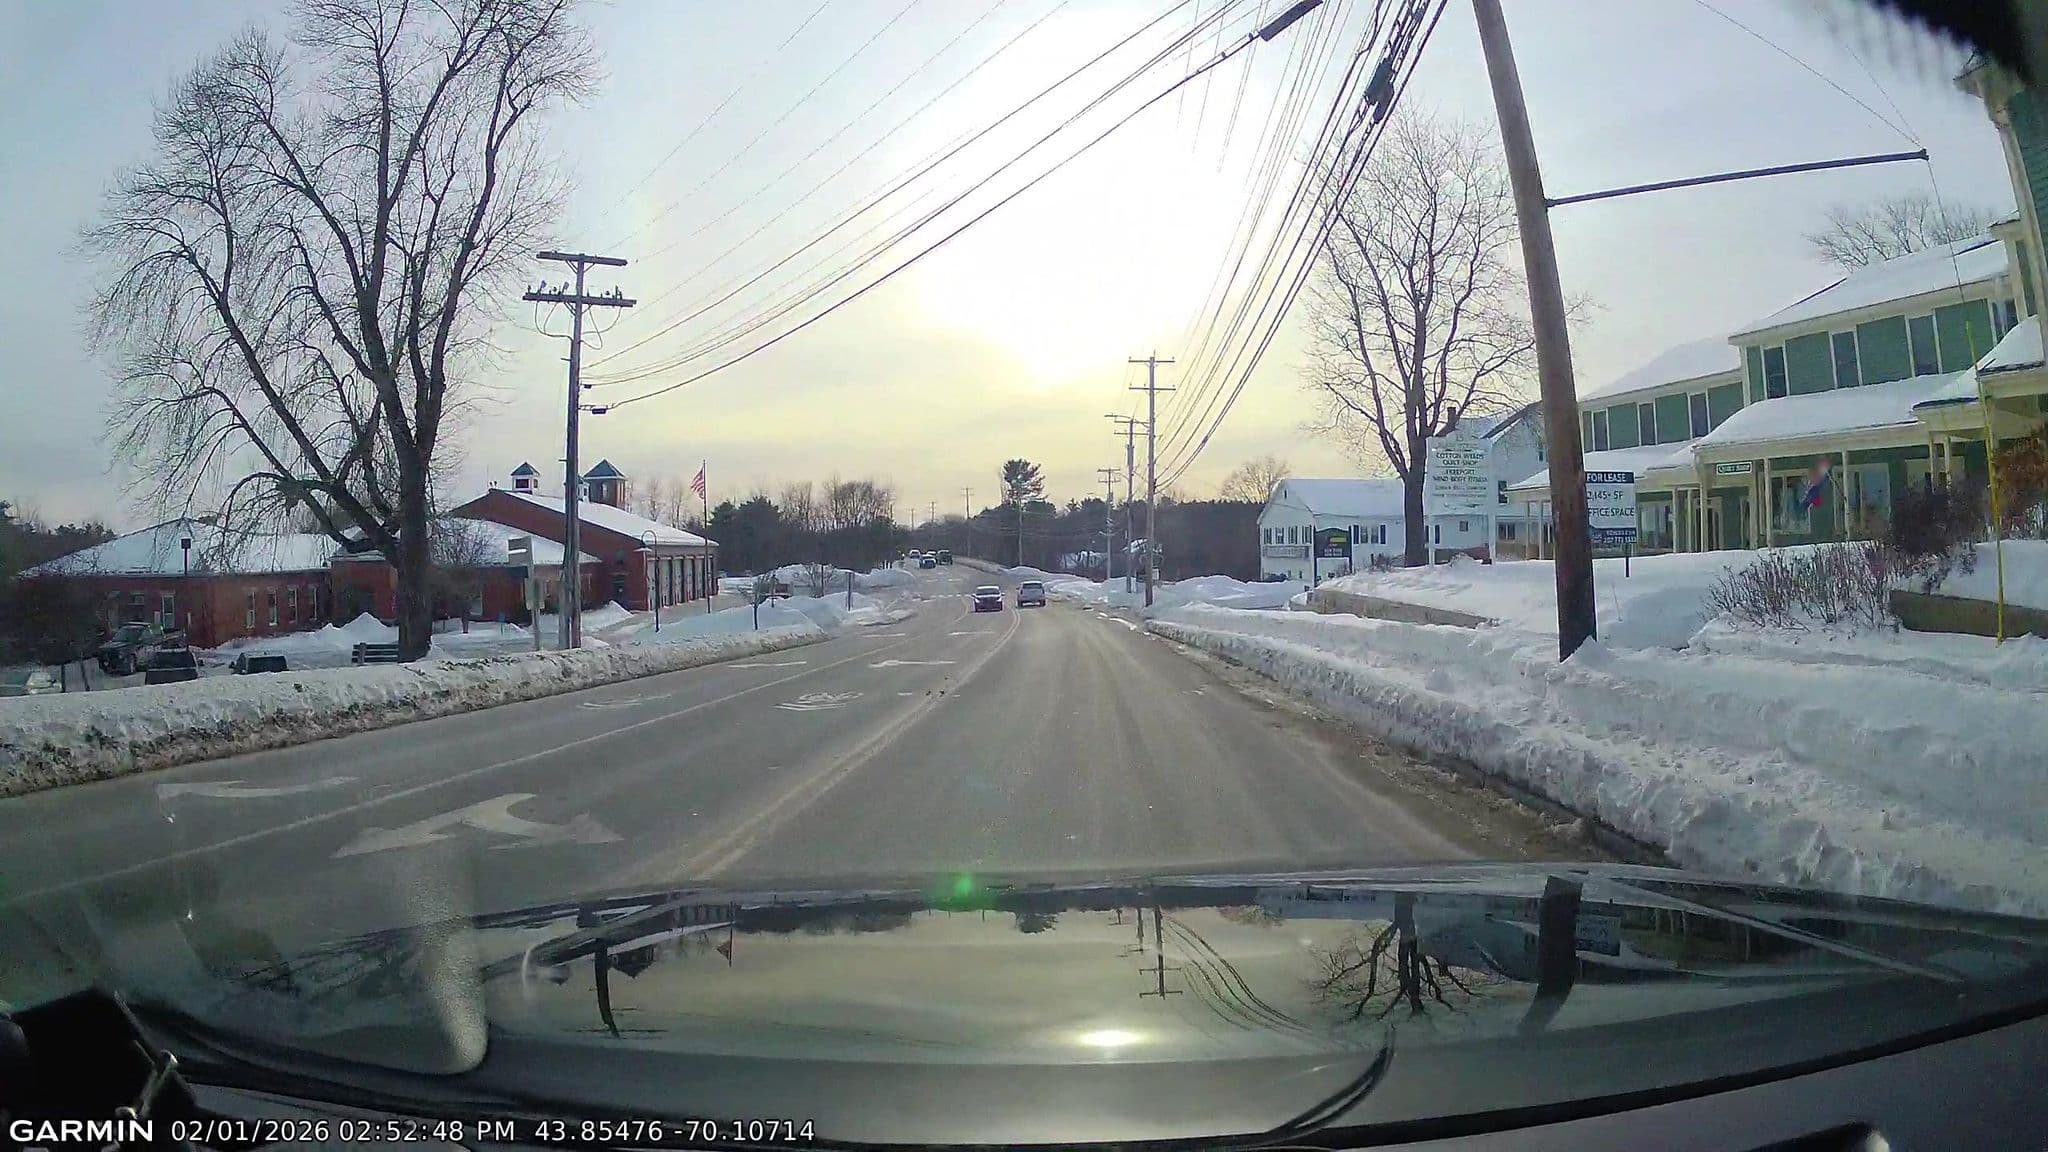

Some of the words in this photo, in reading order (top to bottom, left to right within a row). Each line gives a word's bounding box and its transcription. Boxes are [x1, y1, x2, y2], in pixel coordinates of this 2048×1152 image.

[1586, 473, 1602, 482] FOR
[1603, 473, 1627, 482] LEASE
[1588, 508, 1610, 517] FFICE
[1611, 507, 1635, 517] SPACE
